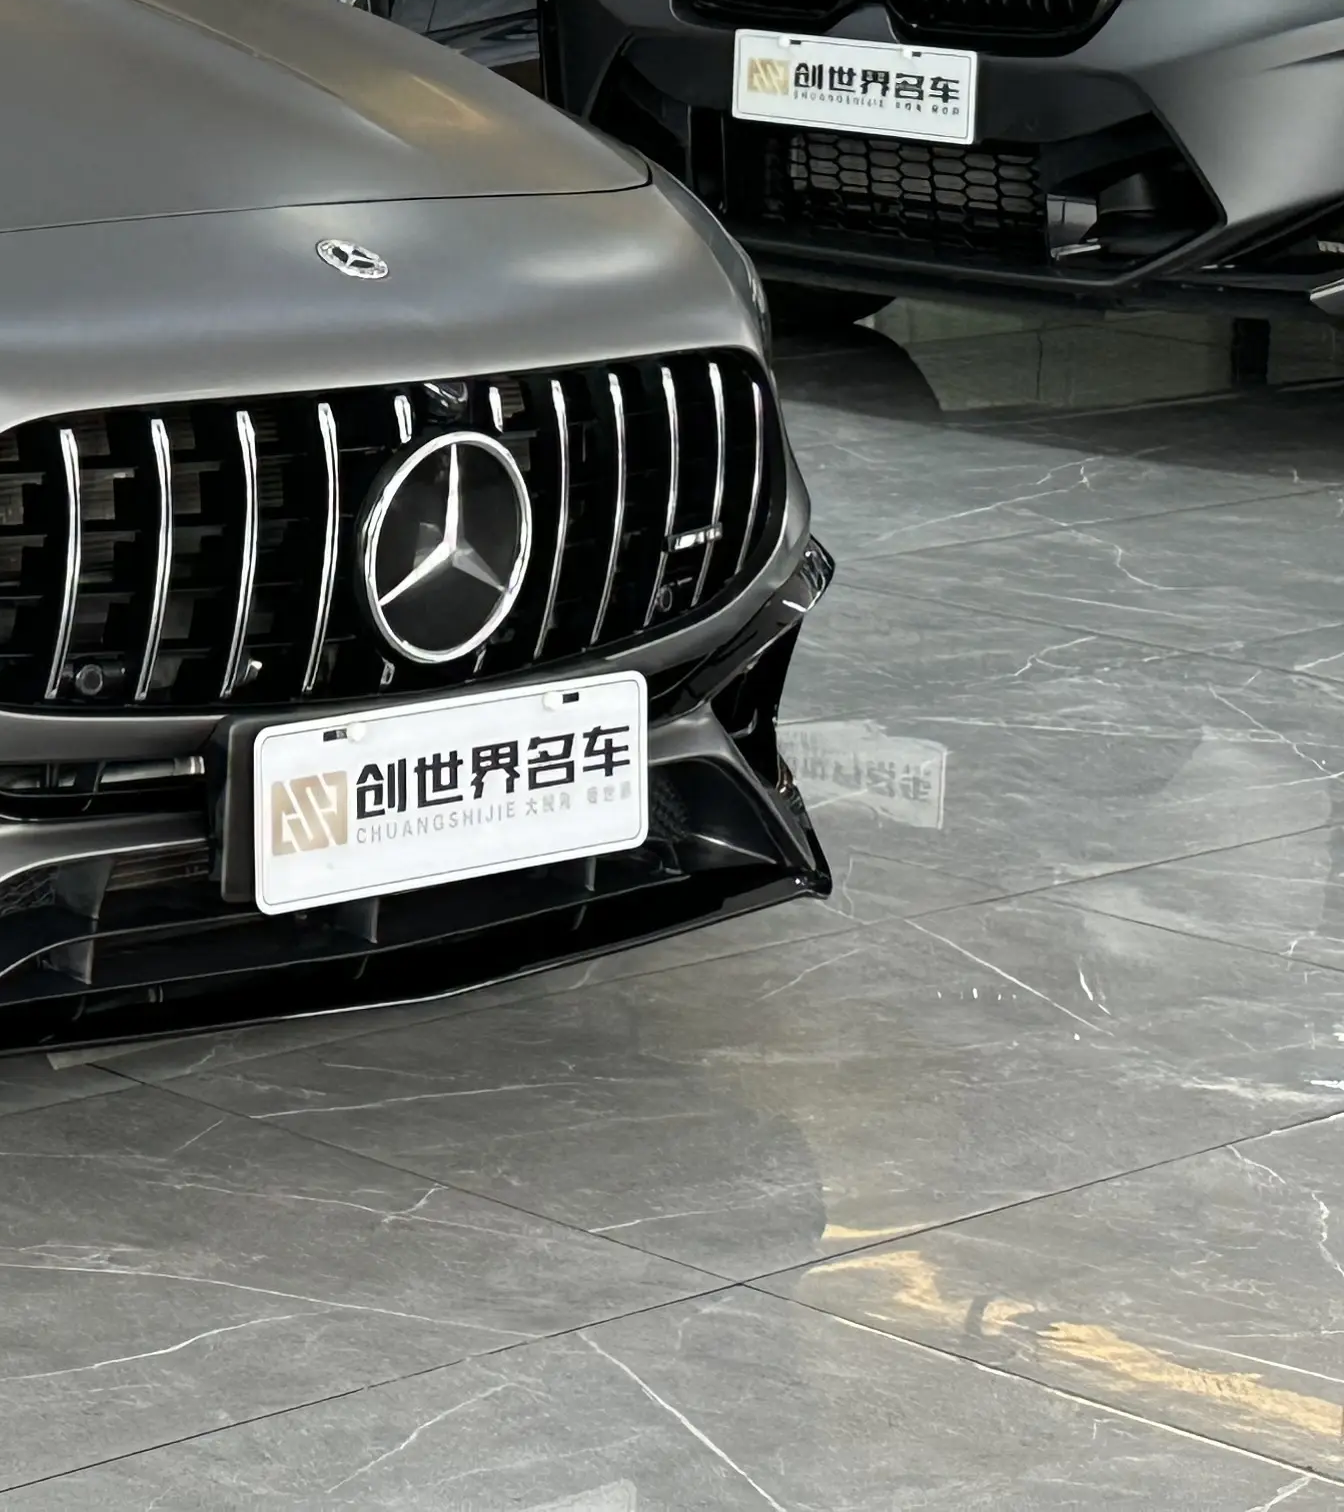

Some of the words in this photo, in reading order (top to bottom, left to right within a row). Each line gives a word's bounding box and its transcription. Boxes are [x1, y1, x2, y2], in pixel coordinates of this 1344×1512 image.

[794, 62, 961, 104] 创世界名车
[356, 725, 631, 820] 创世界名车
[357, 800, 516, 844] CHUANGSHIJIE
